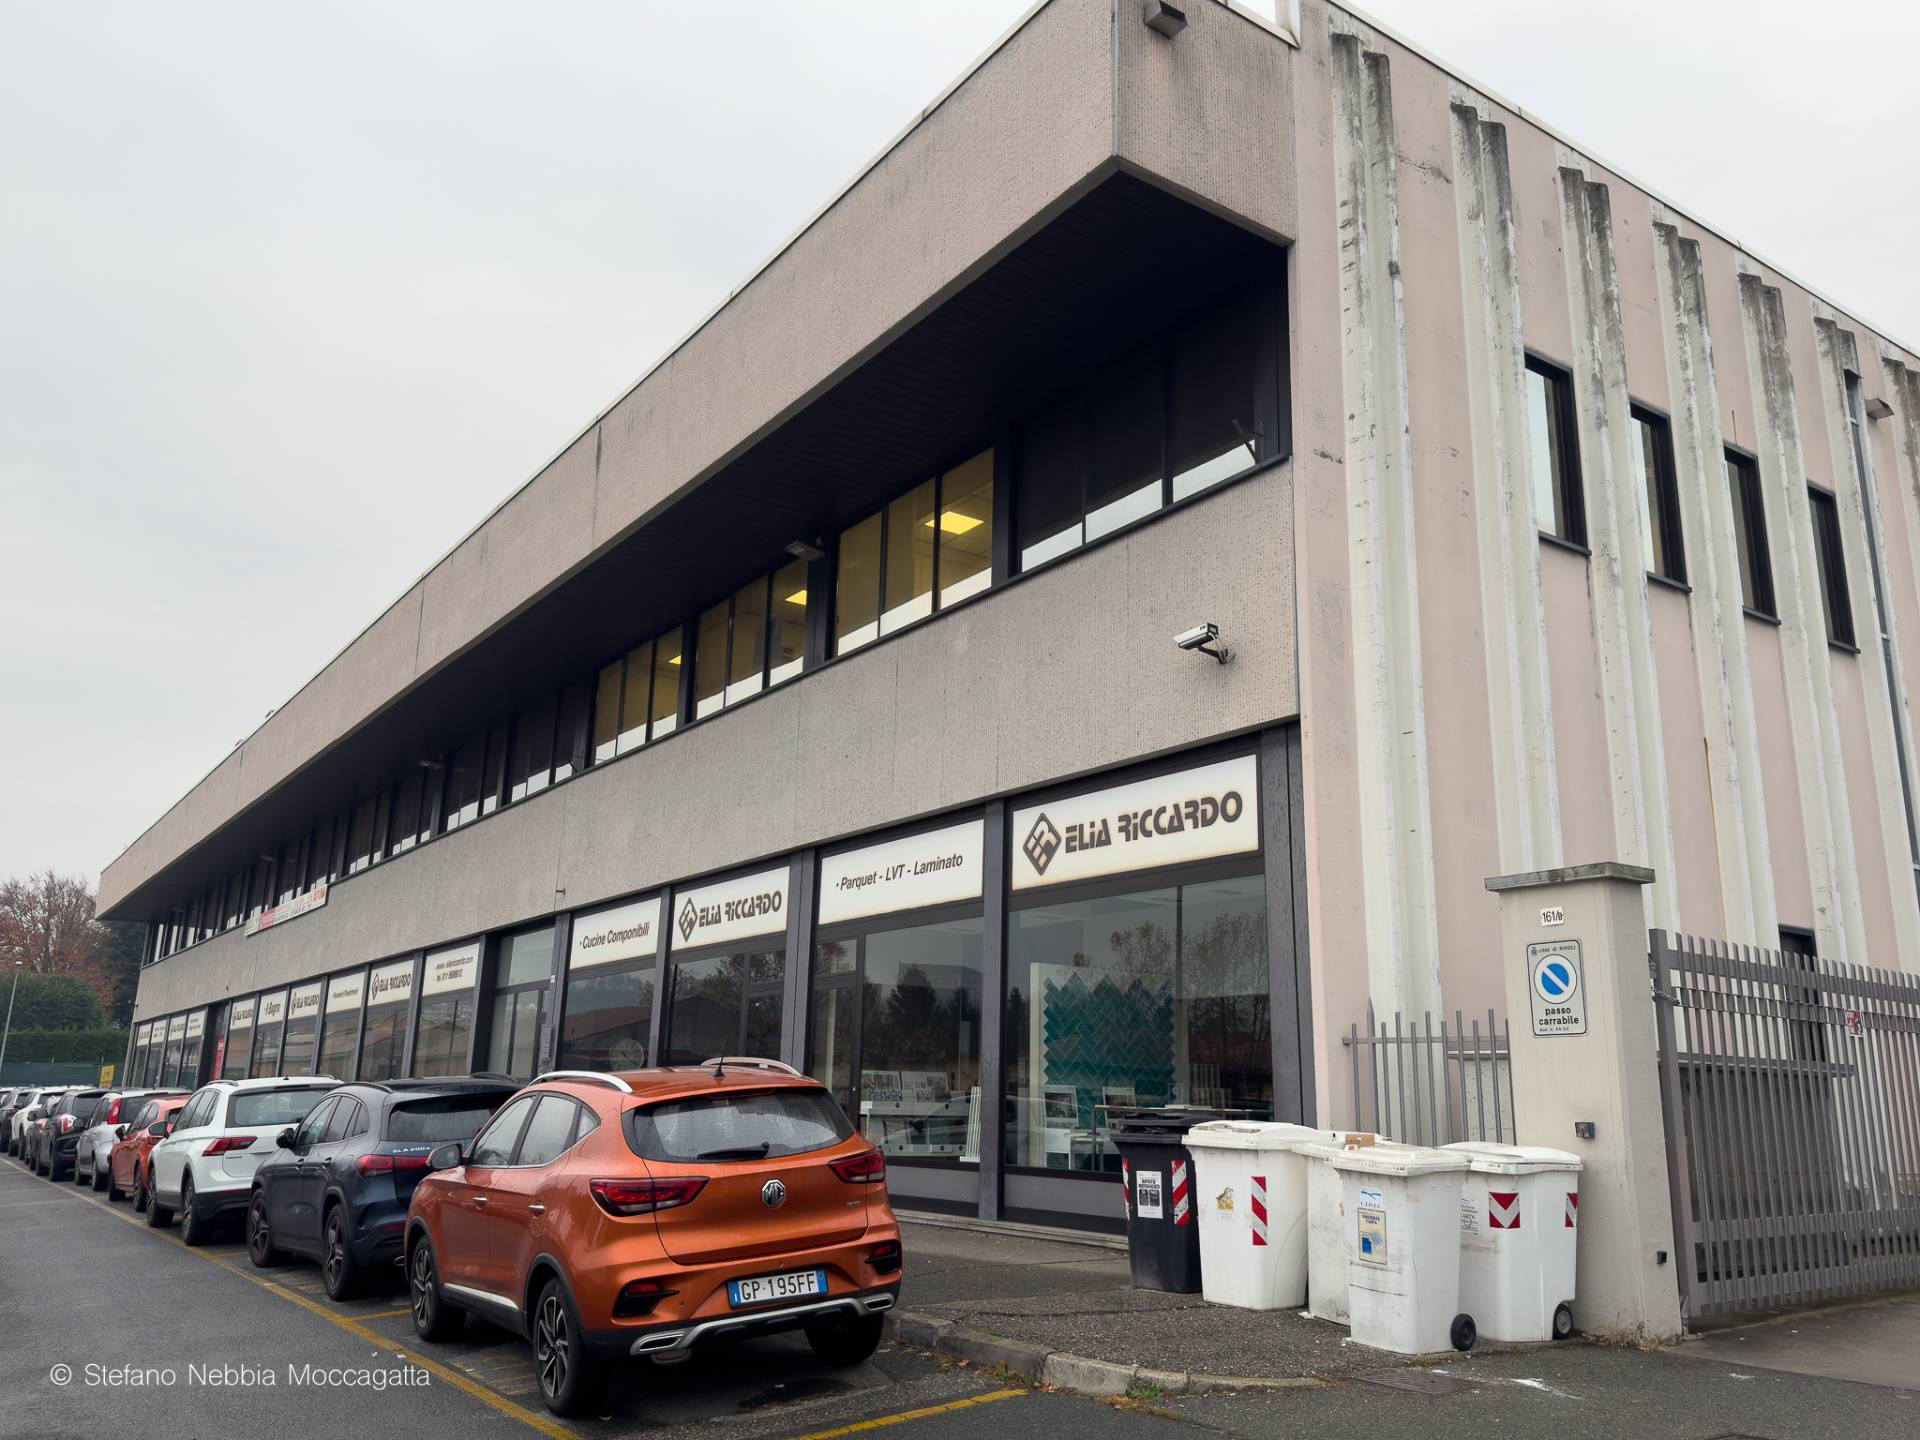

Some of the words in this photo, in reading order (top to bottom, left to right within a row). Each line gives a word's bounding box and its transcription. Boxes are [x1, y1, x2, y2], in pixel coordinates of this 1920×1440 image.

[840, 871, 877, 891] Parquet
[885, 864, 905, 881] LVT
[913, 853, 963, 876] Laminato
[582, 932, 606, 949] Cucine
[607, 921, 650, 944] Componibili
[1538, 1015, 1580, 1026] carrabile
[1545, 1007, 1571, 1016] passo
